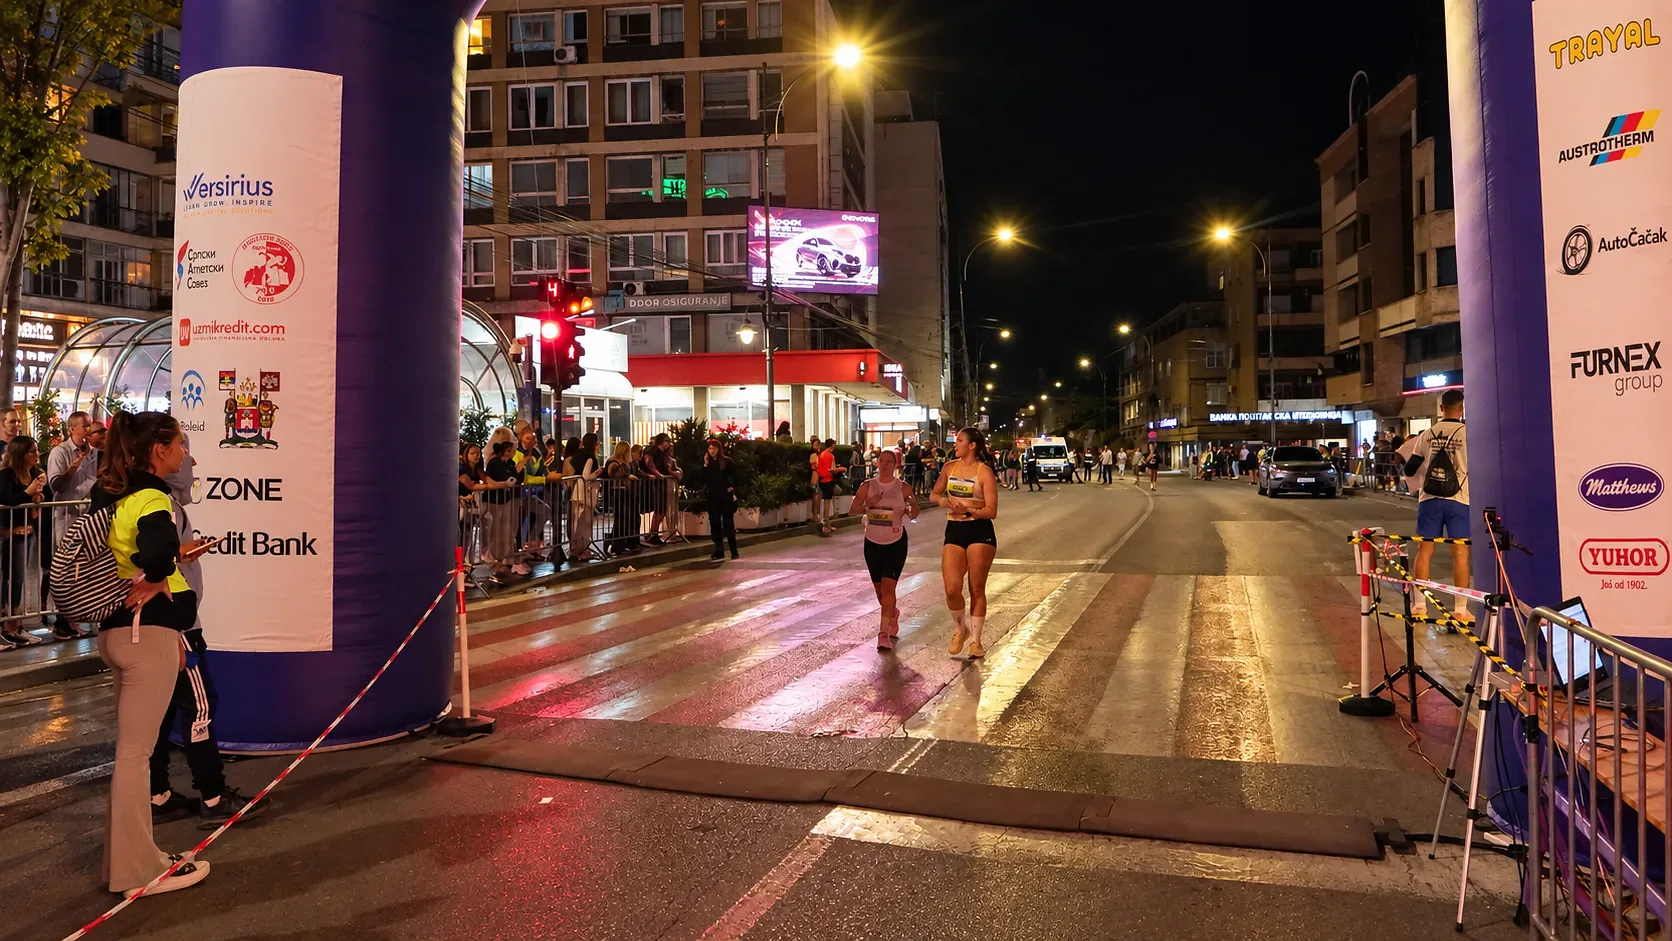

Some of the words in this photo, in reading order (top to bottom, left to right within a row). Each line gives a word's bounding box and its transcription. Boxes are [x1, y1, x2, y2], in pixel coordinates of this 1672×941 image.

[1549, 18, 1661, 69] TRAYAL
[1558, 130, 1654, 163] AUSTROTHERM
[183, 173, 273, 201] Versirius
[1598, 227, 1668, 253] AutoČačak
[548, 282, 557, 297] 4
[629, 299, 659, 307] DDOR
[662, 296, 728, 307] OSIGURANJE
[193, 320, 285, 334] uzmikredit.com
[1570, 341, 1662, 379] FURNEX
[1614, 374, 1663, 396] group
[206, 477, 283, 501] ZONE
[1586, 478, 1657, 497] Matthews
[252, 532, 317, 556] Bank
[1588, 548, 1658, 567] YUHOR
[1614, 580, 1624, 589] od
[1626, 580, 1648, 590] 1902.
